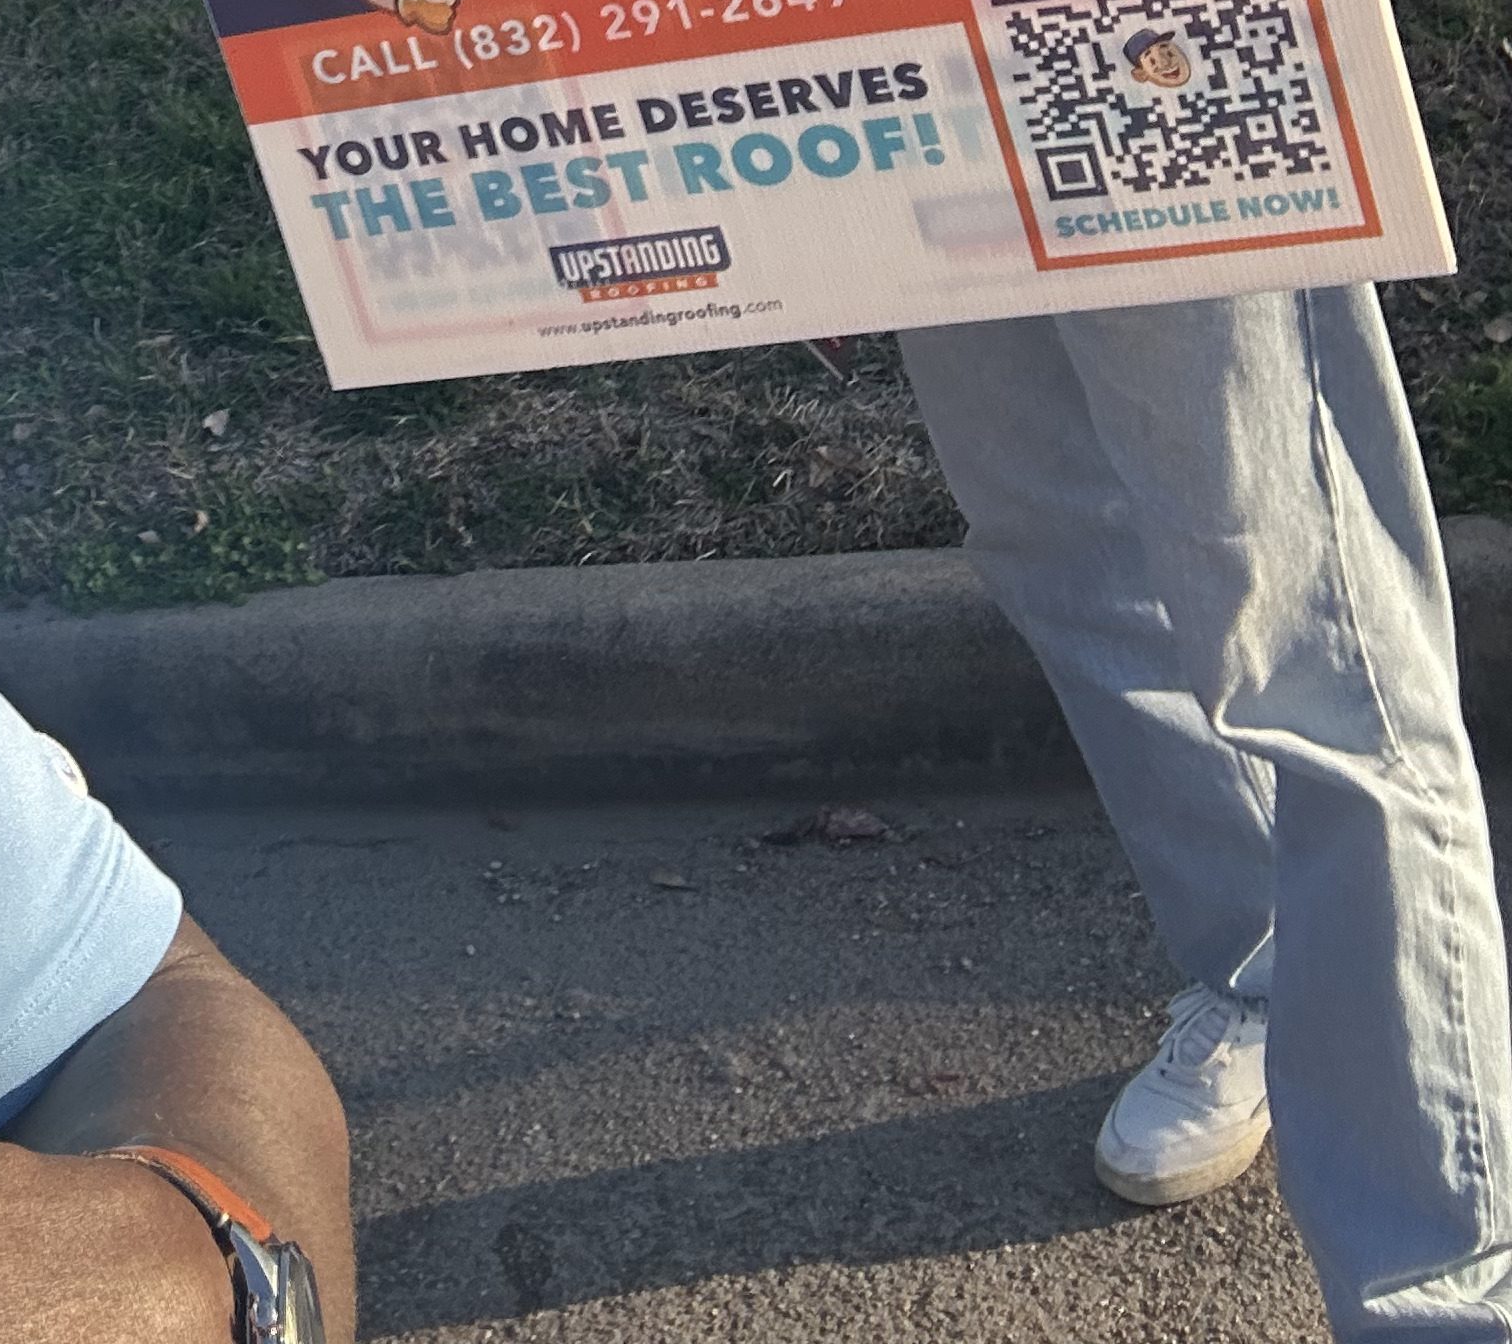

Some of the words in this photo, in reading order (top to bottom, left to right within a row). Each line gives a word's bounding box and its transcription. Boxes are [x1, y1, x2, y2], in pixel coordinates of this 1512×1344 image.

[312, 33, 438, 85] CALL
[453, 14, 582, 70] (832)
[298, 130, 448, 180] YOUR
[460, 99, 626, 158] HOME
[640, 62, 930, 135] DESERVES
[311, 179, 457, 240] THE
[473, 148, 650, 224] BEST
[687, 114, 946, 195] ROOF!
[1055, 200, 1230, 238] SCHEDULE
[1237, 188, 1341, 221] NOW!
[558, 233, 722, 282] UPSTANDING
[539, 299, 783, 336] www.upstandingroofing.com
